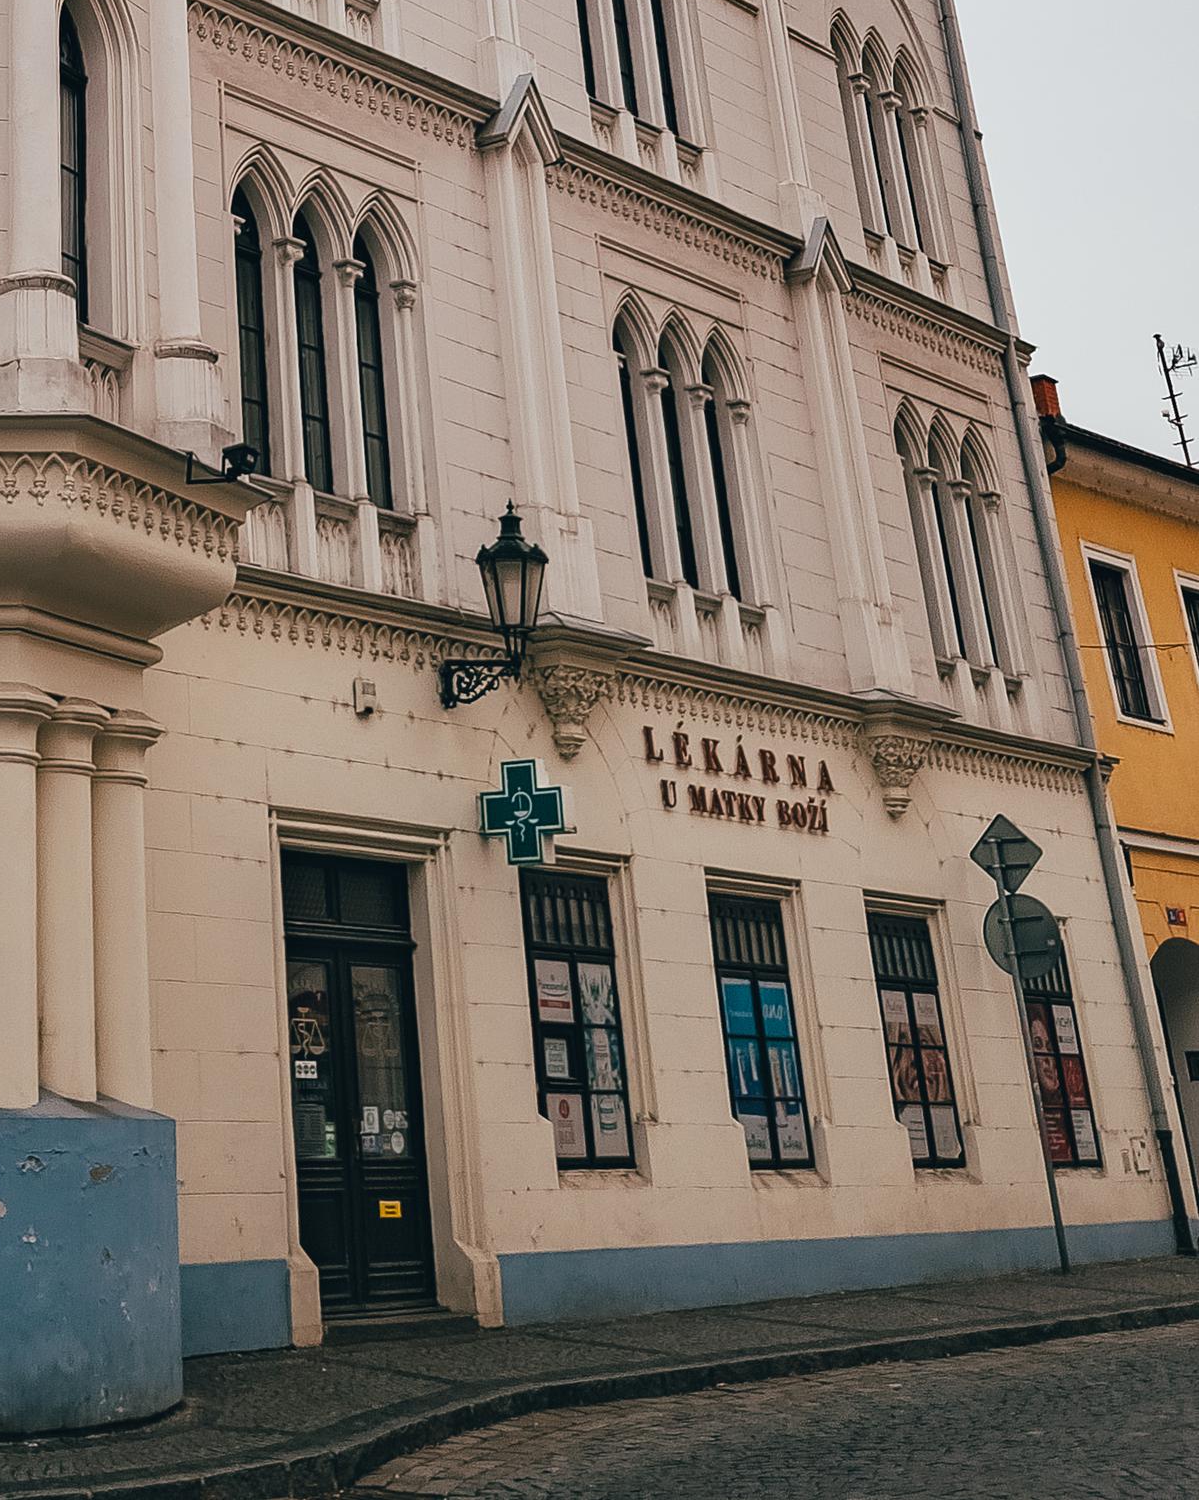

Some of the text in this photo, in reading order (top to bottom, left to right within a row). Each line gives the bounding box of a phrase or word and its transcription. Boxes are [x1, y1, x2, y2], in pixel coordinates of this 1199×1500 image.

[643, 720, 836, 792] LÉKÁRNA
[660, 779, 830, 833] U MATKY BOŽÍ
